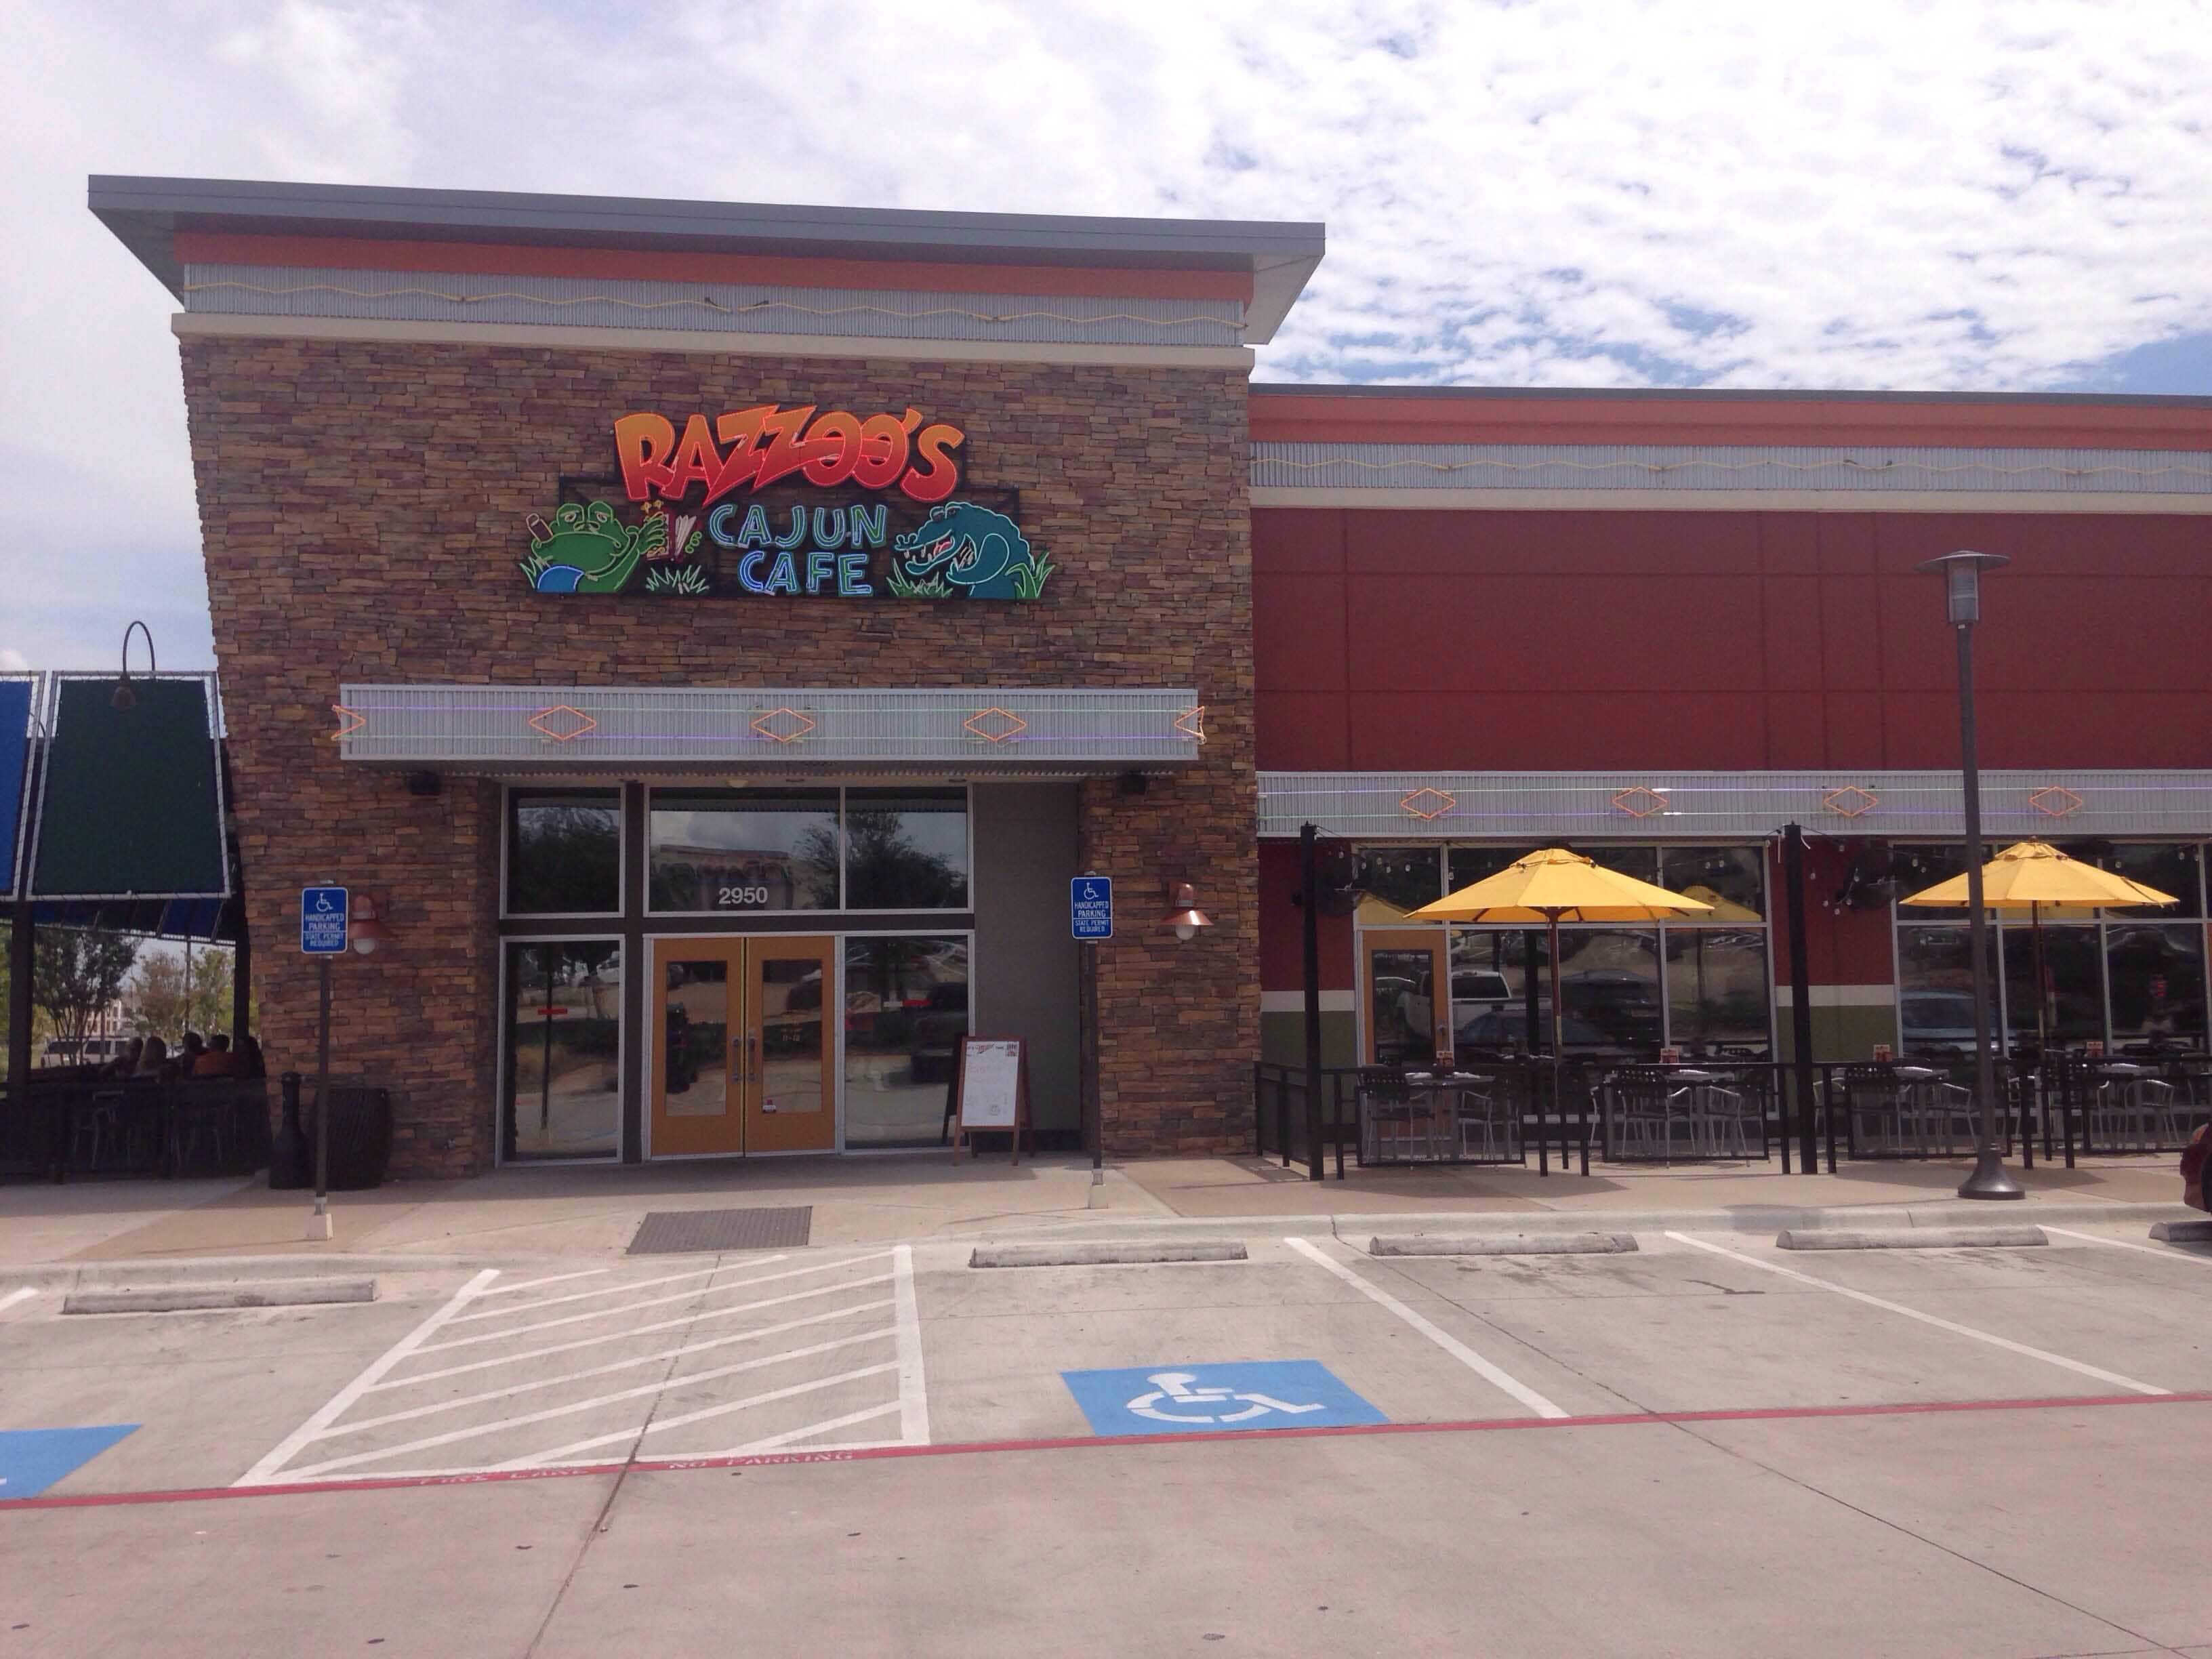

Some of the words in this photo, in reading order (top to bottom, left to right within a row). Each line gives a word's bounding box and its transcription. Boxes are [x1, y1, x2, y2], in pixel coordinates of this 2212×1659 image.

[613, 404, 965, 509] RAZZOO'S
[709, 504, 888, 550] CAJUN
[738, 550, 875, 596] CAFE
[718, 886, 769, 905] 2950
[1074, 901, 1109, 909] HANDICAPPED
[305, 913, 344, 922] HANDICAPPED
[1078, 909, 1106, 918] PARKING
[308, 922, 340, 930] PARKING
[727, 1450, 854, 1466] PARKING
